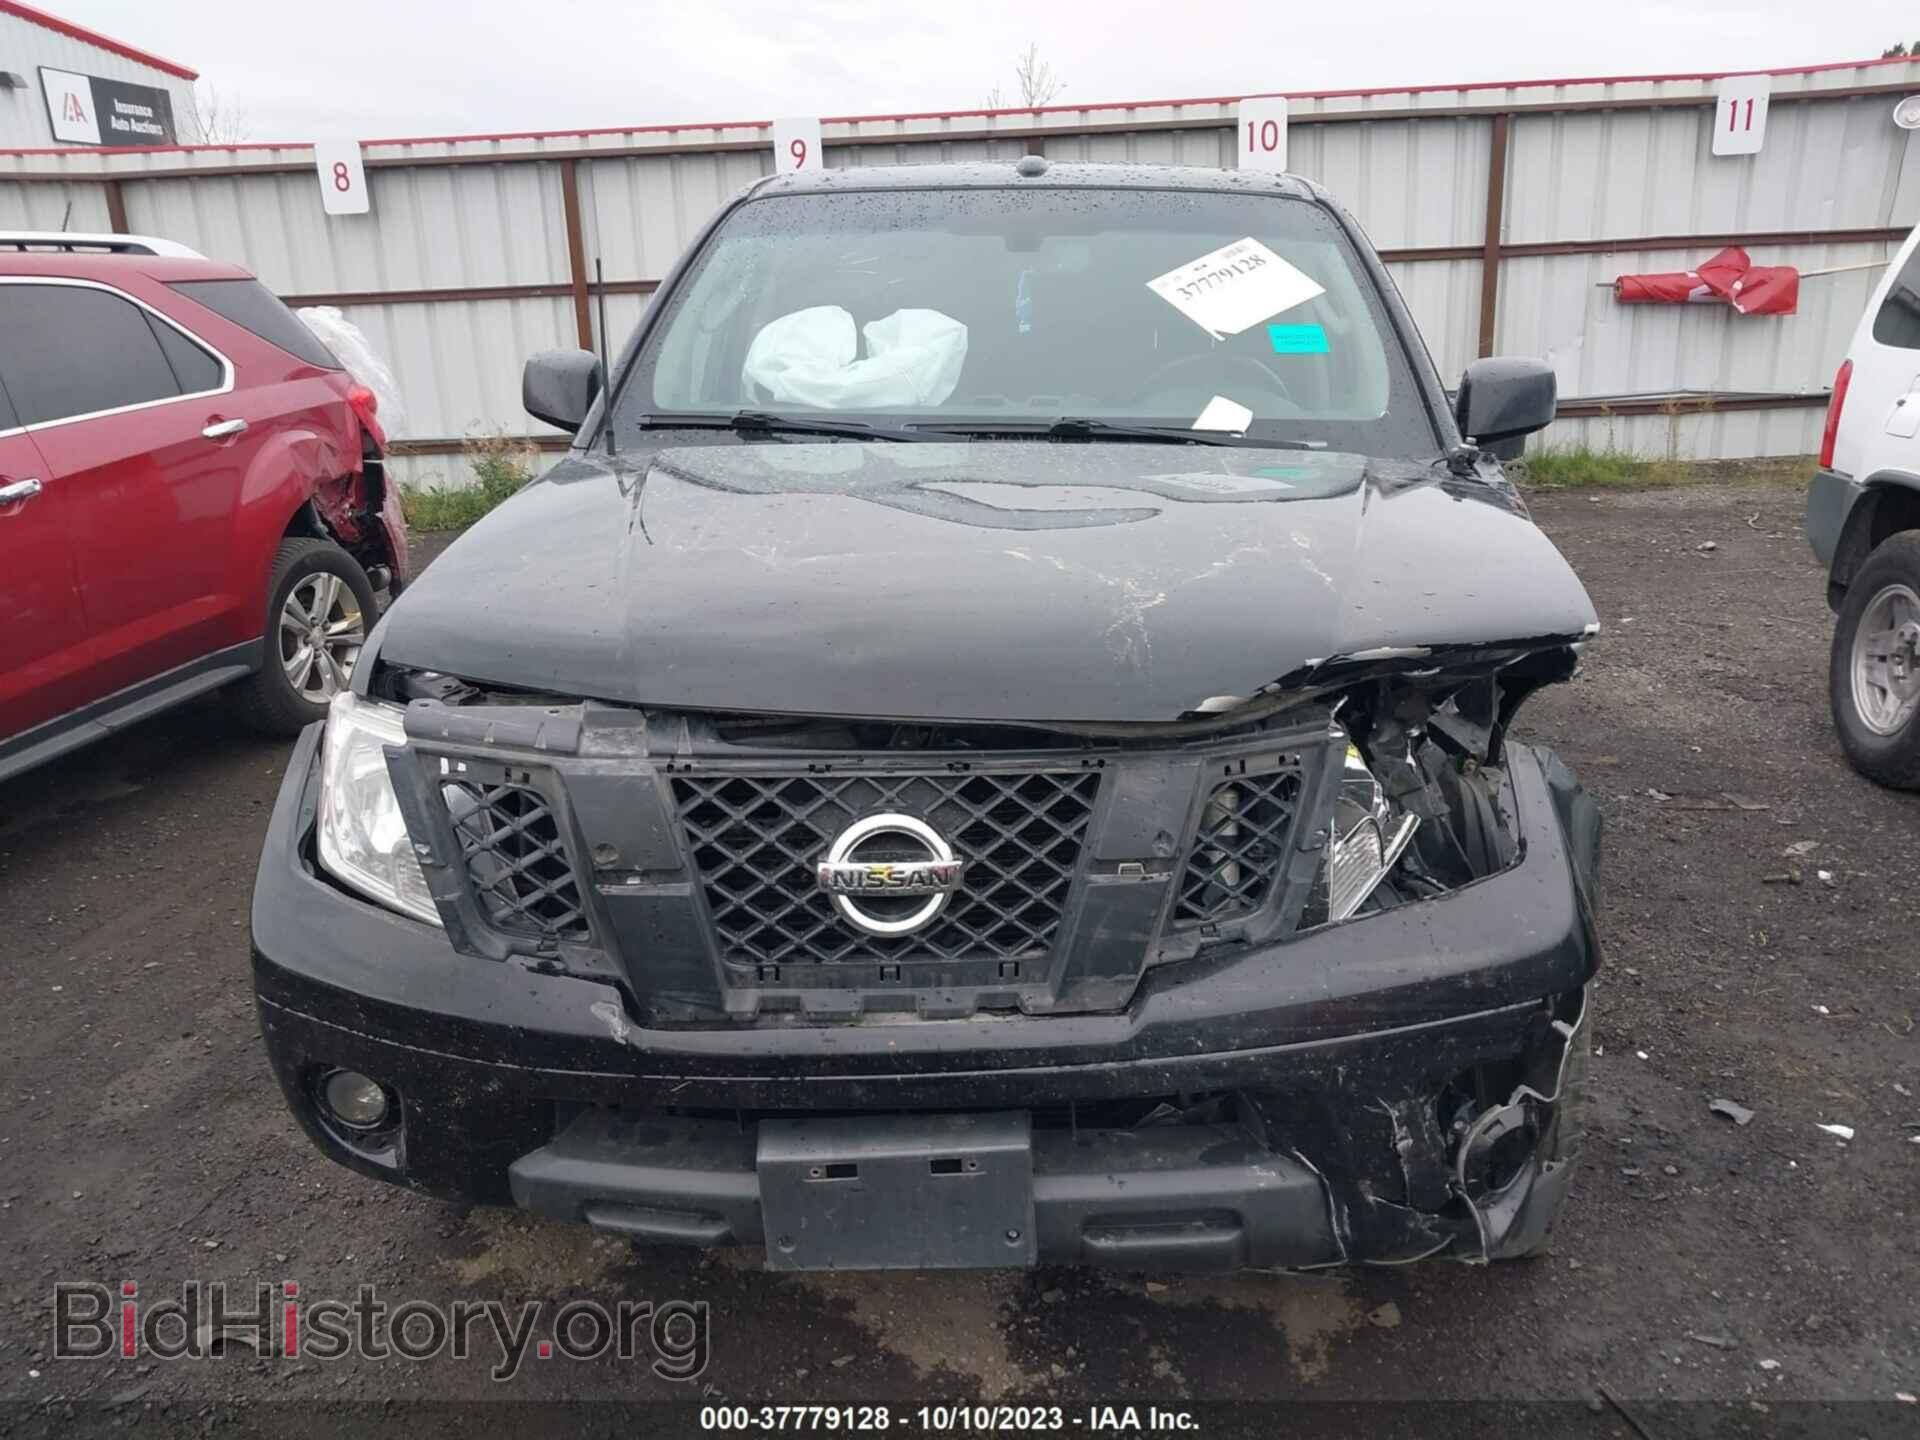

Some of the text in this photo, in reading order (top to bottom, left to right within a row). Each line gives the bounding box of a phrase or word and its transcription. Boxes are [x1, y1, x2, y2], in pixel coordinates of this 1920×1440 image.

[1730, 98, 1754, 132] 11
[1247, 119, 1278, 153] 10
[790, 139, 806, 169] 9
[333, 161, 350, 192] 8
[832, 868, 951, 889] NISSAN
